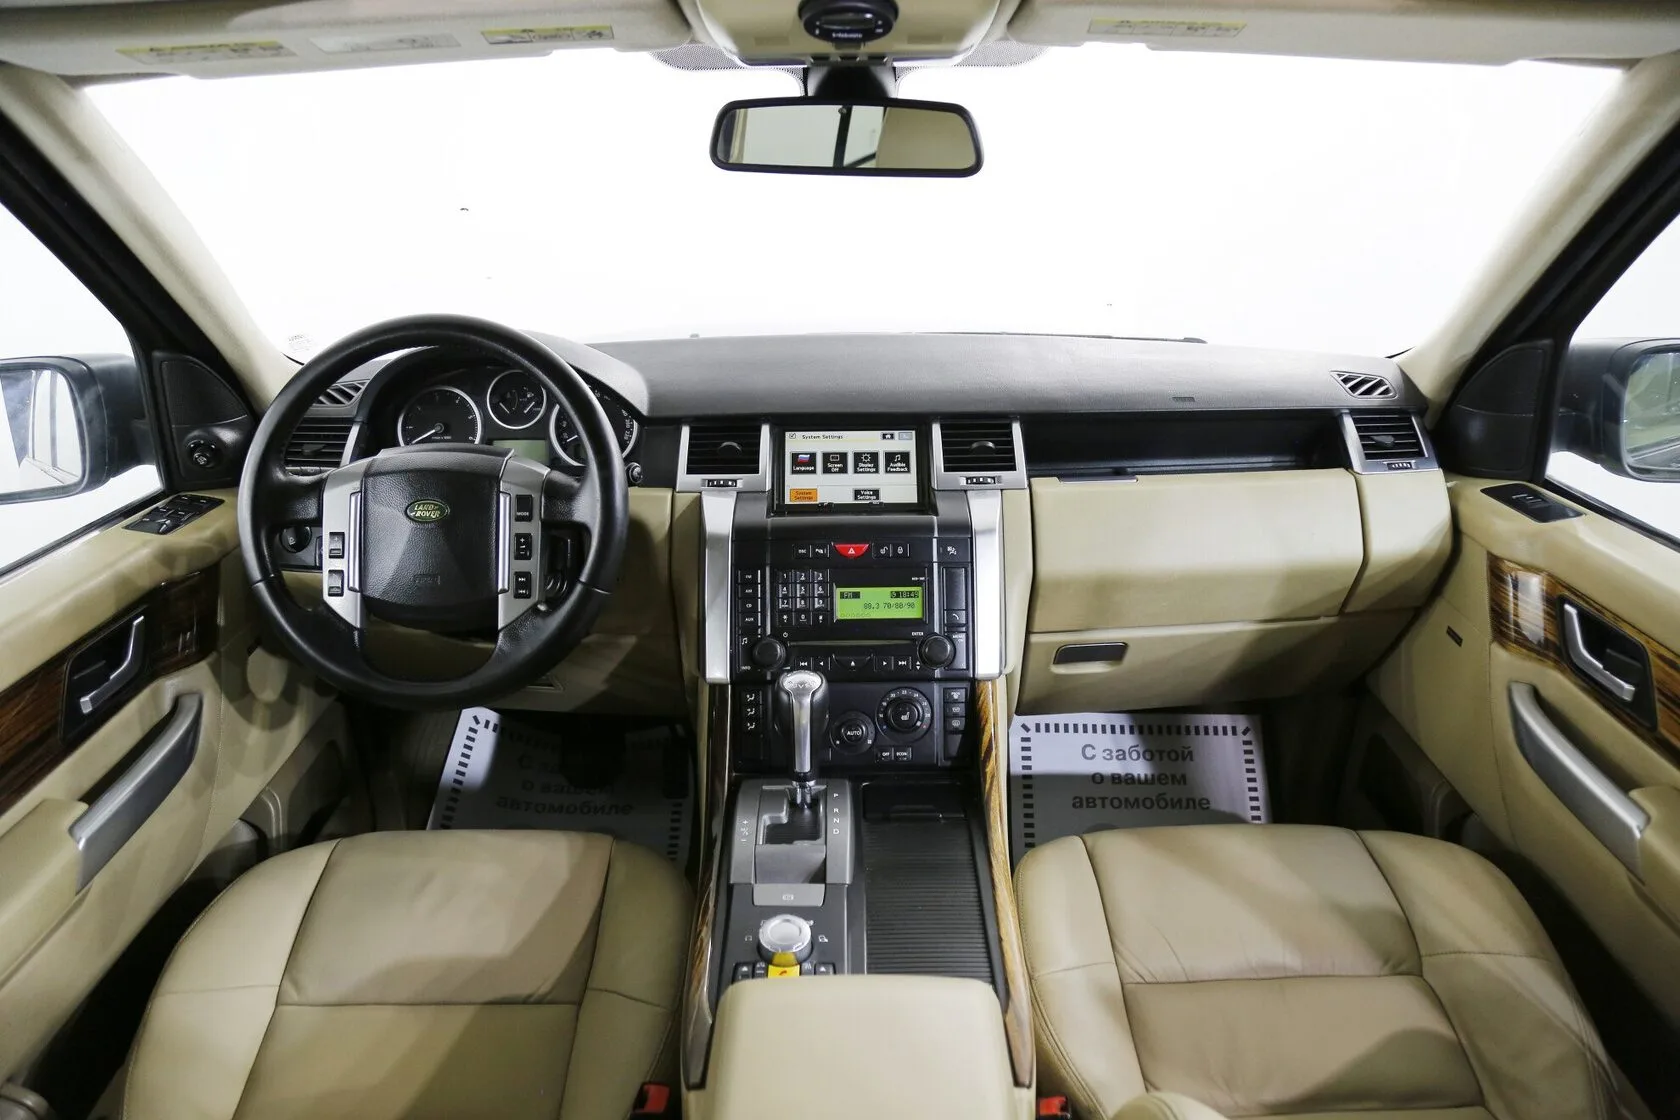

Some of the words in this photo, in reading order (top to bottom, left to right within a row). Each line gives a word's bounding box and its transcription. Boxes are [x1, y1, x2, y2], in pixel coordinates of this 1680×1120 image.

[1081, 744, 1096, 760] С
[1102, 745, 1194, 762] заботой
[1091, 772, 1104, 785] о
[1111, 772, 1187, 786] вашем
[496, 796, 634, 815] автомобиле
[1072, 793, 1211, 810] автомобиле
